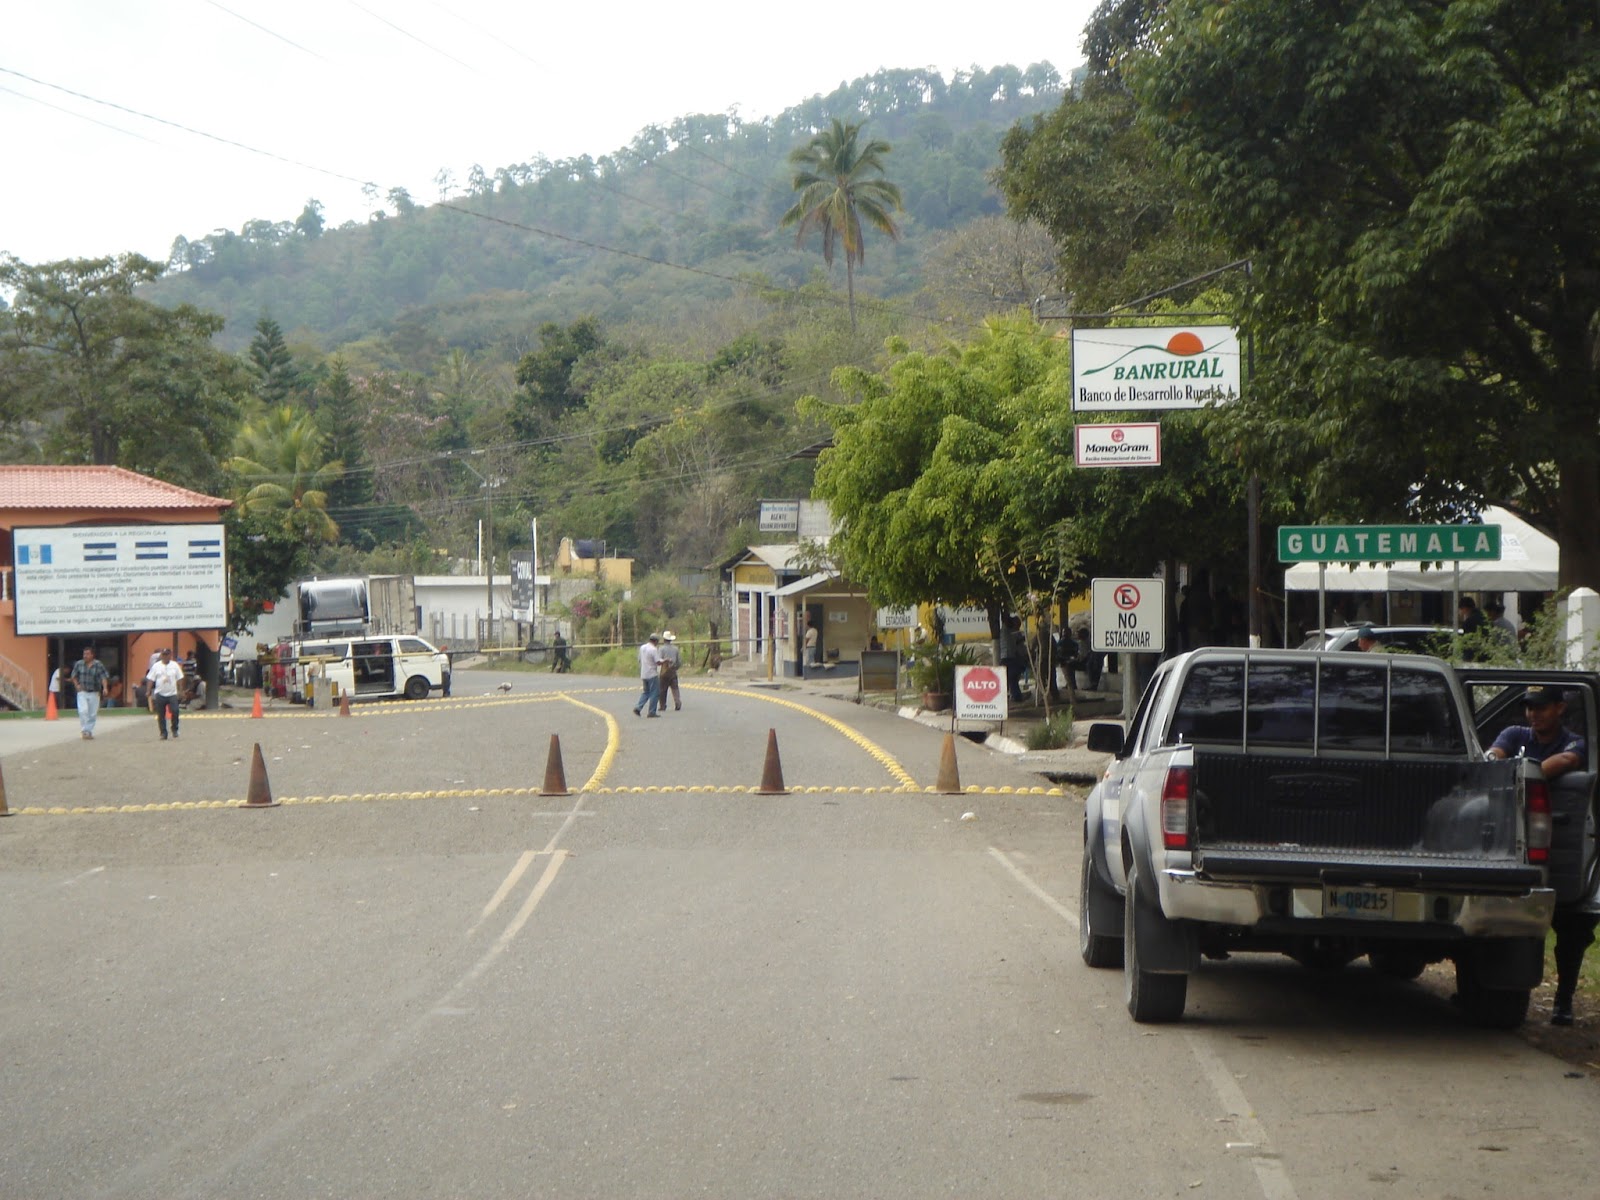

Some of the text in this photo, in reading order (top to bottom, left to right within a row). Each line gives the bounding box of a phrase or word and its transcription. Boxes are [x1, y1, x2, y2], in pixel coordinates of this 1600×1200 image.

[1113, 357, 1224, 380] BANRURAL
[1080, 387, 1112, 402] Banco
[1114, 386, 1127, 401] de
[1129, 385, 1183, 401] Desarrollo
[1085, 443, 1149, 454] MoneyGram
[1288, 532, 1490, 554] GUATEMALA
[1118, 613, 1137, 629] NO
[1105, 631, 1151, 647] ESTACIONAR
[967, 680, 997, 690] ALTO
